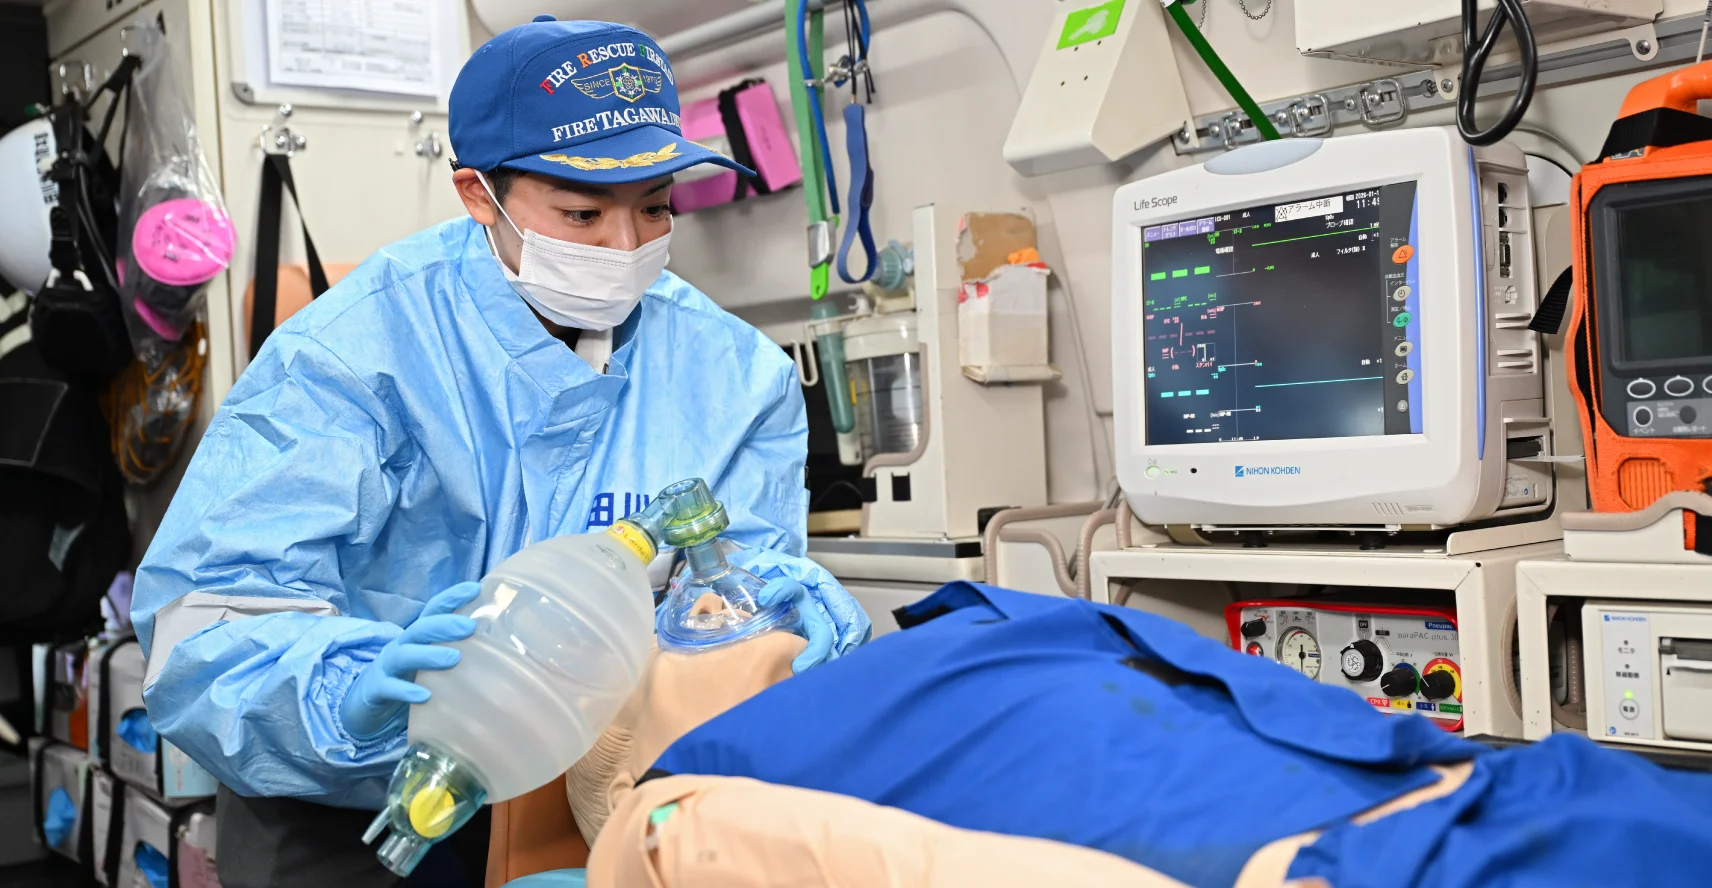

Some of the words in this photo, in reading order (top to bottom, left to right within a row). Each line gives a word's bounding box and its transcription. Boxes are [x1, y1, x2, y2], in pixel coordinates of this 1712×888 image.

[539, 61, 577, 95] FIRE
[576, 43, 635, 68] RESCUE
[584, 79, 611, 91] SINCE
[551, 118, 598, 142] FIRE
[1134, 200, 1149, 211] Life
[1151, 194, 1178, 208] Scope
[1287, 199, 1331, 214] アラーム中断
[1246, 467, 1269, 476] NIHON
[1270, 466, 1300, 475] KOHDEN
[1428, 622, 1453, 630] Pneupac
[1398, 631, 1429, 640] paraPAC
[1431, 632, 1448, 641] plus
[1370, 697, 1381, 705] CPR
